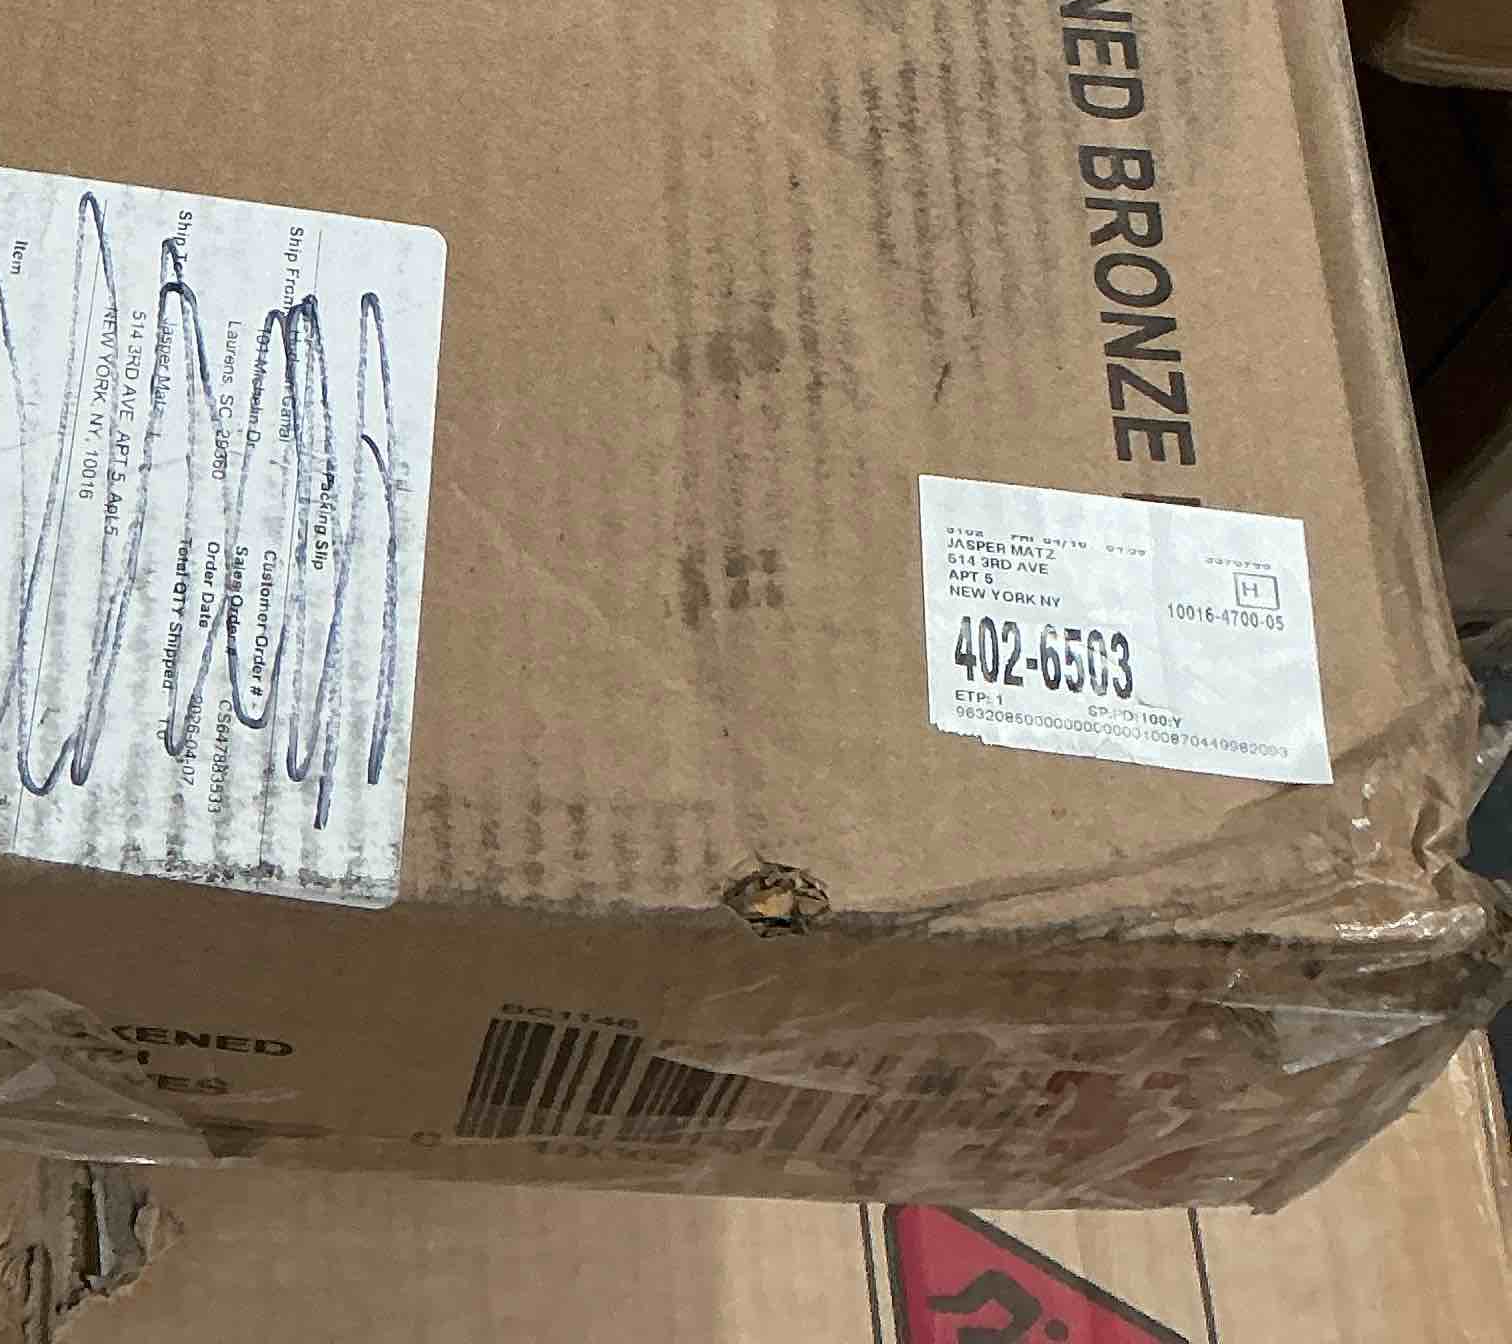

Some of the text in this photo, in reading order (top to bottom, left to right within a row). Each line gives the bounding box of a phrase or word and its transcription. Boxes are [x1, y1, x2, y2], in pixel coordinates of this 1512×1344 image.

[174, 209, 194, 247] Ship
[283, 225, 305, 264] Ship
[9, 240, 30, 276] Item
[1077, 143, 1200, 469] BRONZE
[129, 310, 147, 343] 514
[124, 345, 144, 381] 3RD
[119, 383, 138, 422] AVE
[205, 541, 220, 589] Order
[312, 538, 329, 572] Slip
[946, 538, 1057, 562] JASPER MATZ
[947, 552, 1049, 575] 514 3RD AVE
[948, 568, 979, 584] APT
[949, 584, 1062, 609] NEW YORK NY
[248, 549, 278, 683] Customer Order
[1166, 602, 1286, 632] 10016-4700-05
[954, 615, 1135, 701] 402-6503
[499, 1002, 643, 1032] BC1146
